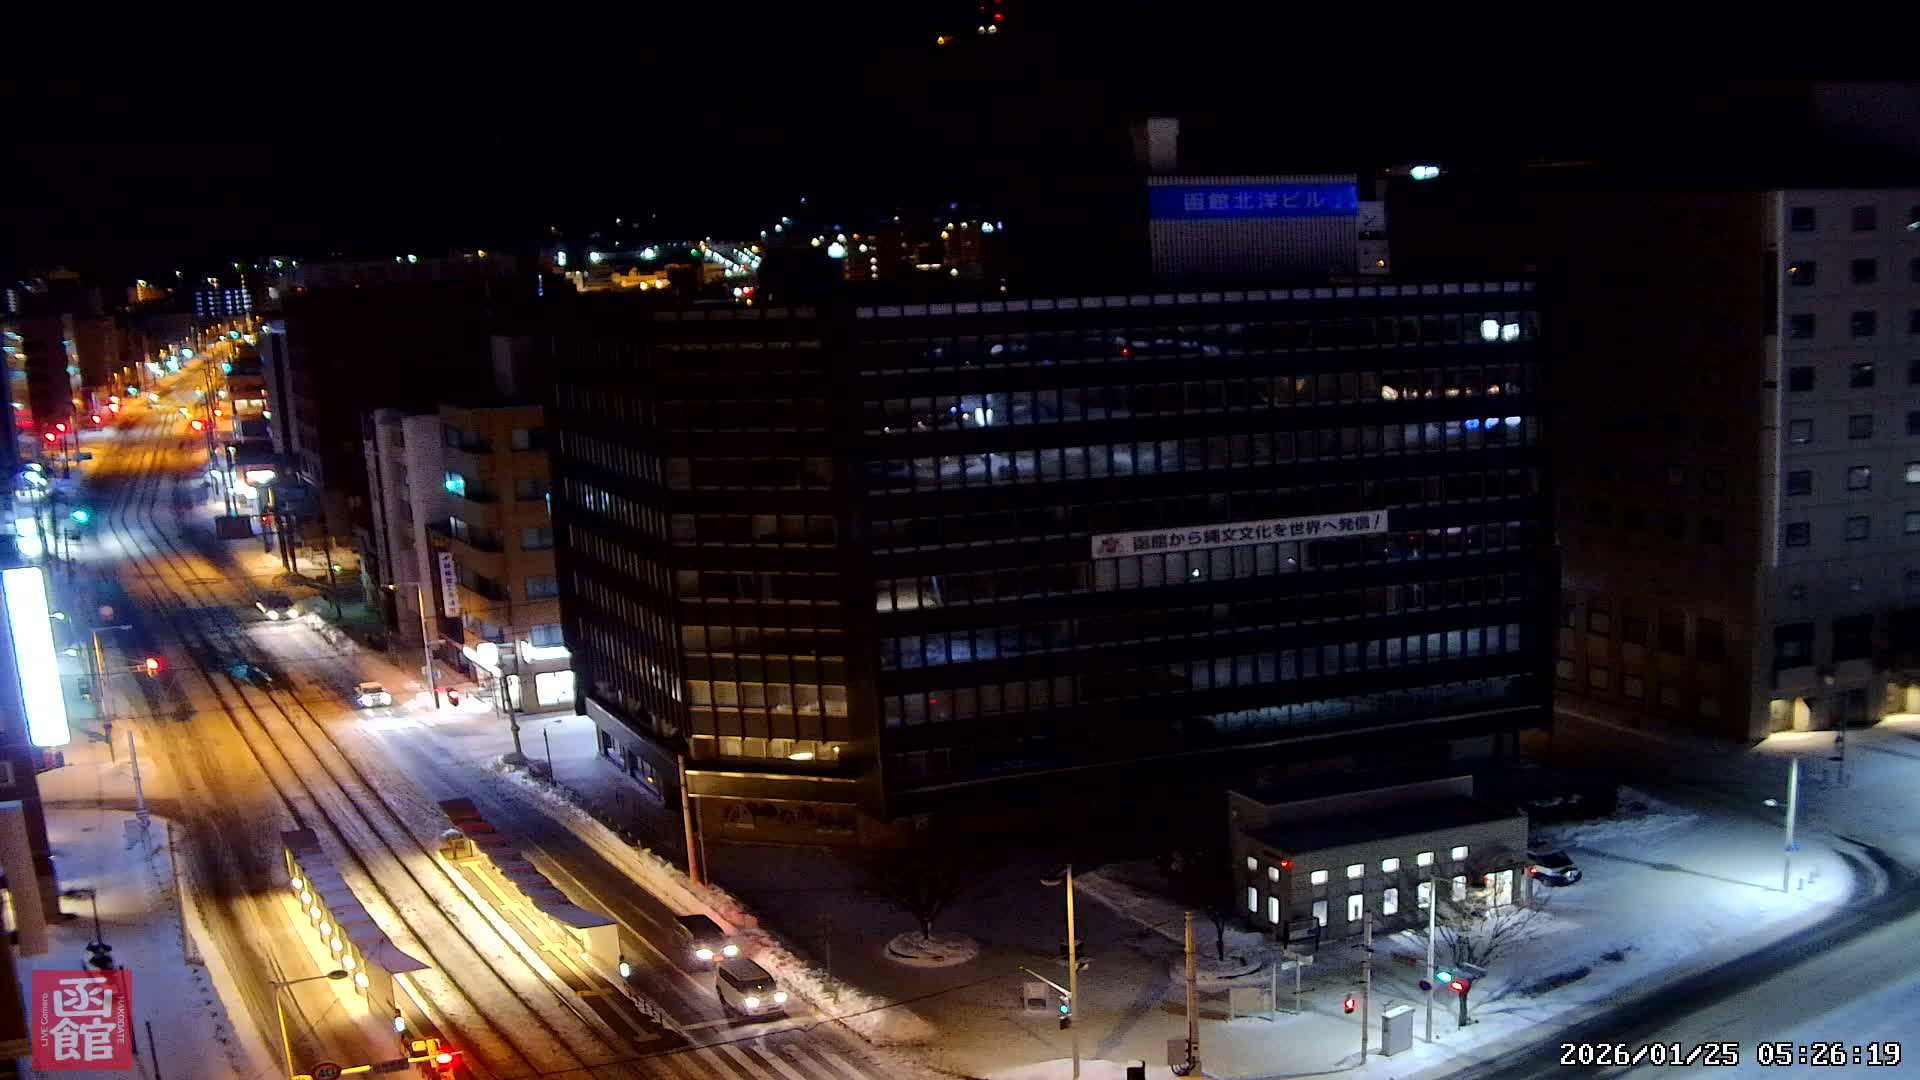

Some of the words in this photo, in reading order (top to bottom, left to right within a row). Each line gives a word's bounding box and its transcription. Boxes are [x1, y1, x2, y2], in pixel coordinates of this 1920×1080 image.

[1183, 191, 1325, 211] 函館北洋ビル
